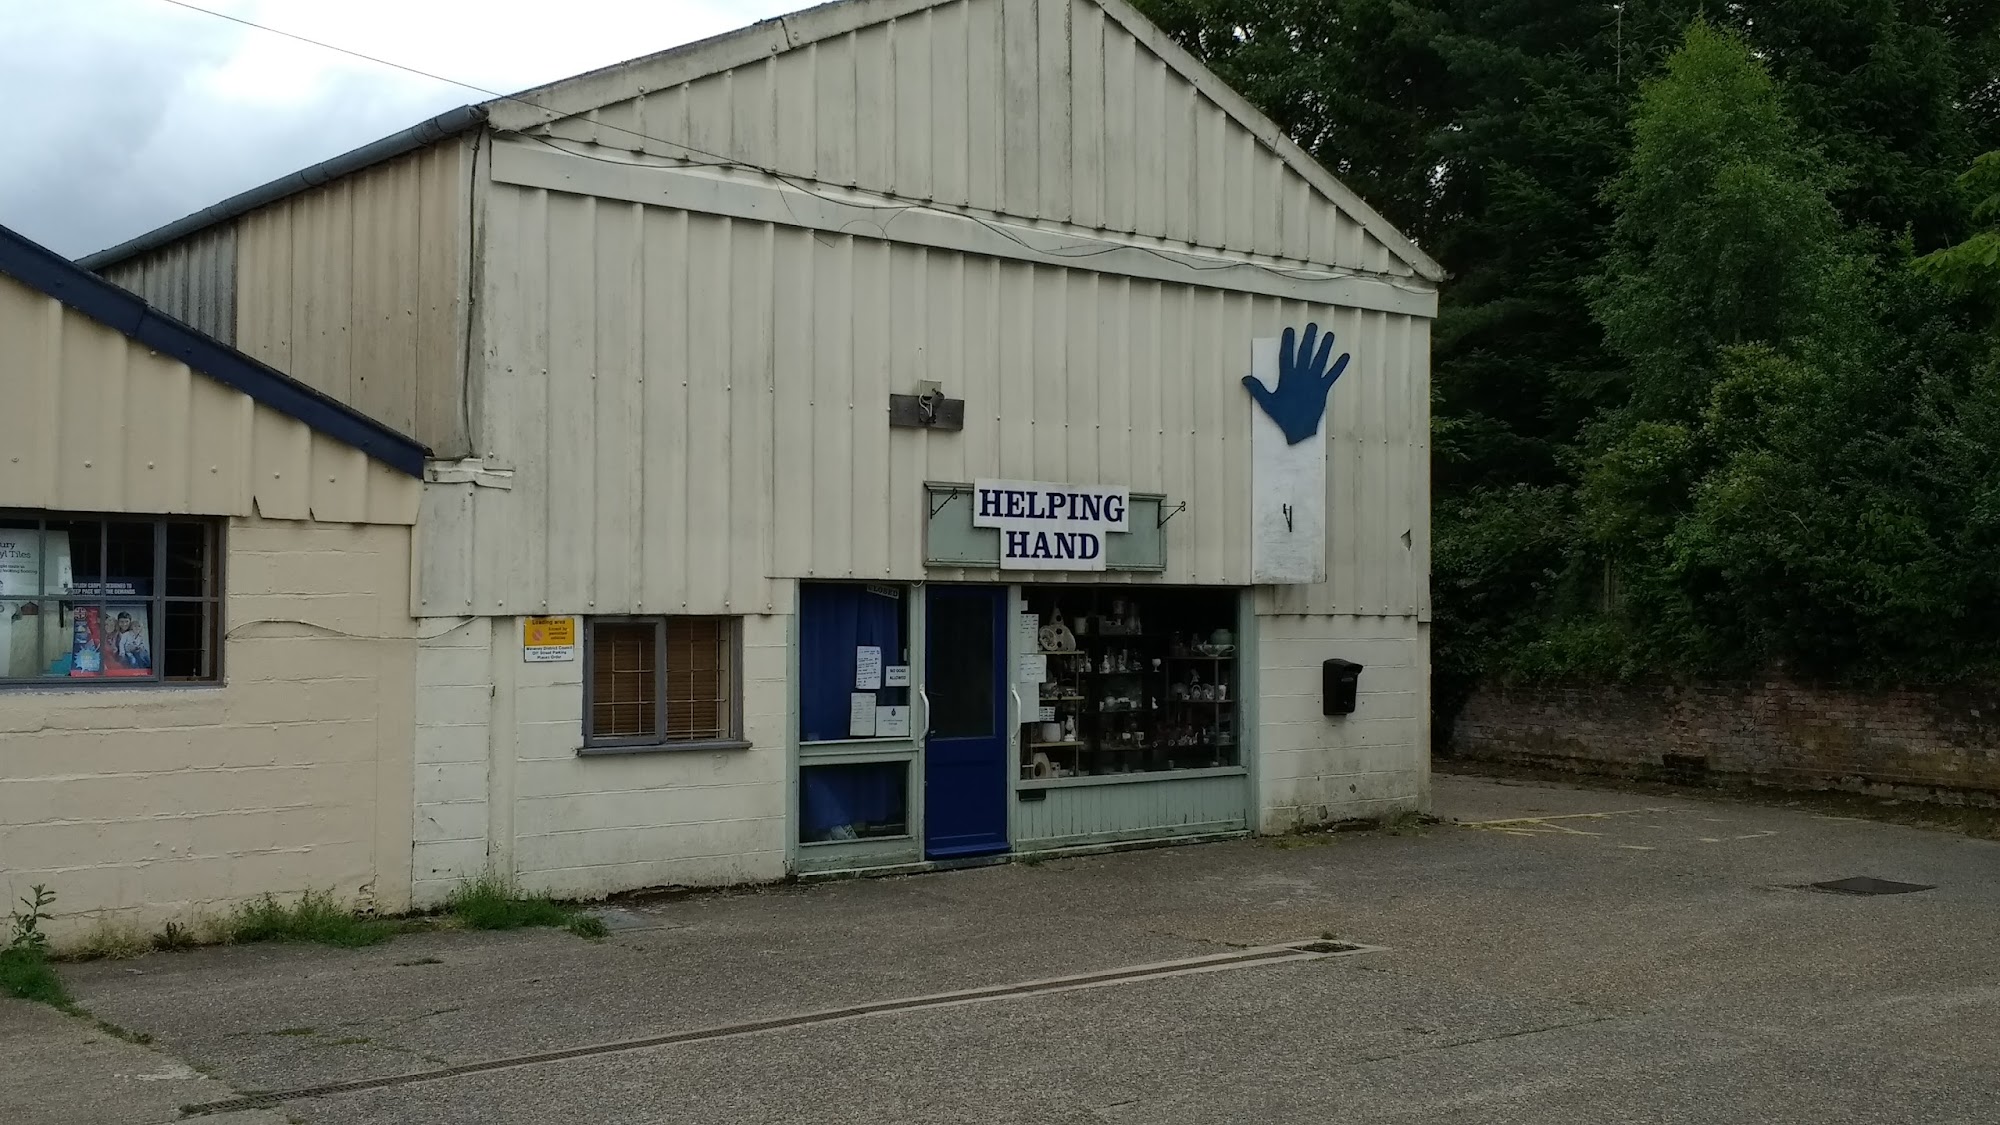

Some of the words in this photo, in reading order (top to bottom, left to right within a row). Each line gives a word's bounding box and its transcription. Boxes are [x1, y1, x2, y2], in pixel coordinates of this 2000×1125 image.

[979, 488, 1125, 523] HELPING
[8, 550, 32, 559] Tiles
[1005, 530, 1100, 560] HAND
[868, 584, 898, 597] CLOSED
